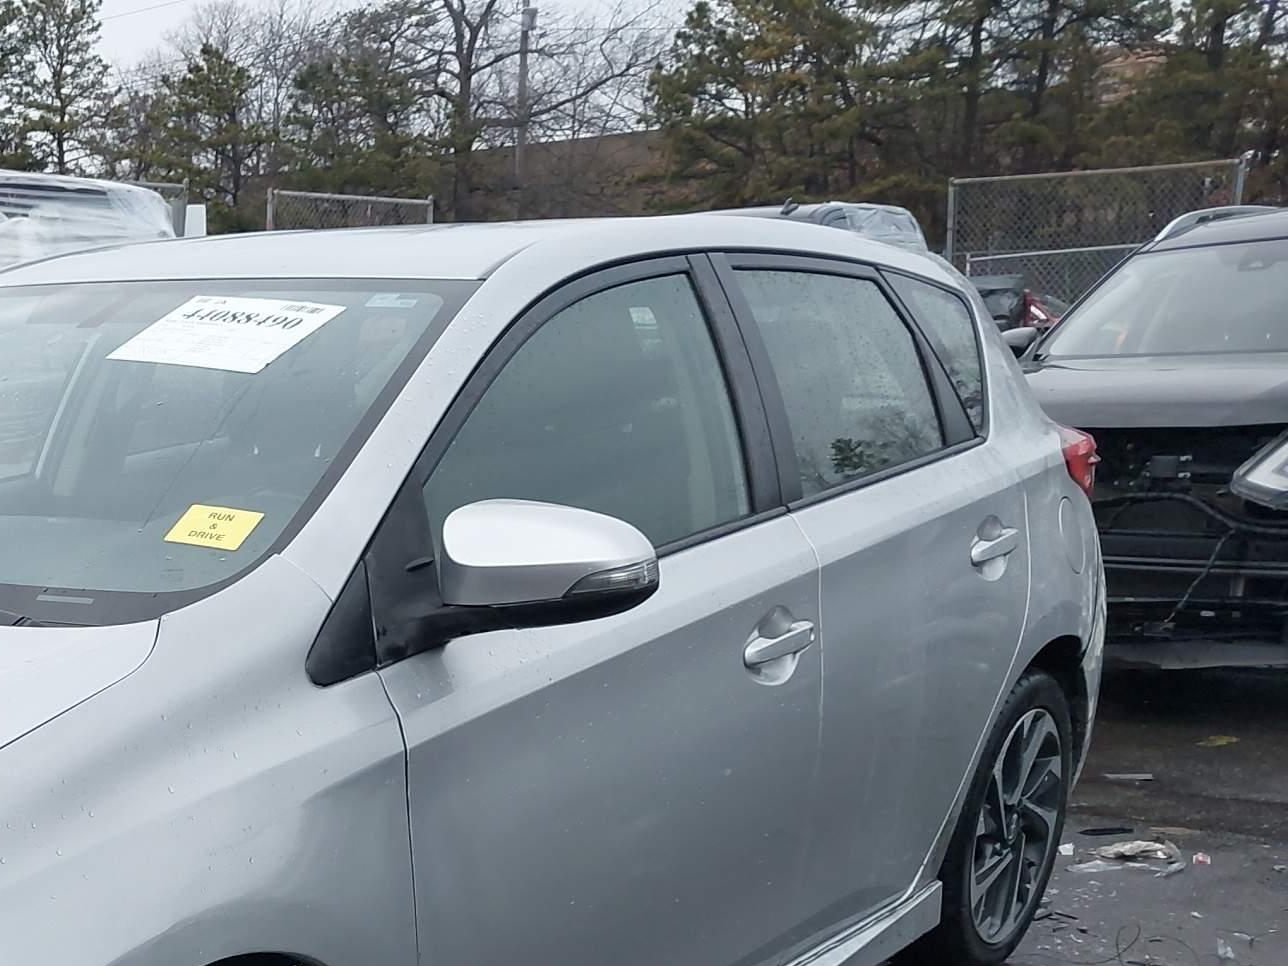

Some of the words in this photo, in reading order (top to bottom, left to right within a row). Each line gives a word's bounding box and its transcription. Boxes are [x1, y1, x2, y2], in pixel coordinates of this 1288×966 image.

[182, 307, 304, 331] 44088490
[208, 512, 236, 522] RUN
[187, 530, 226, 541] DRIVE
